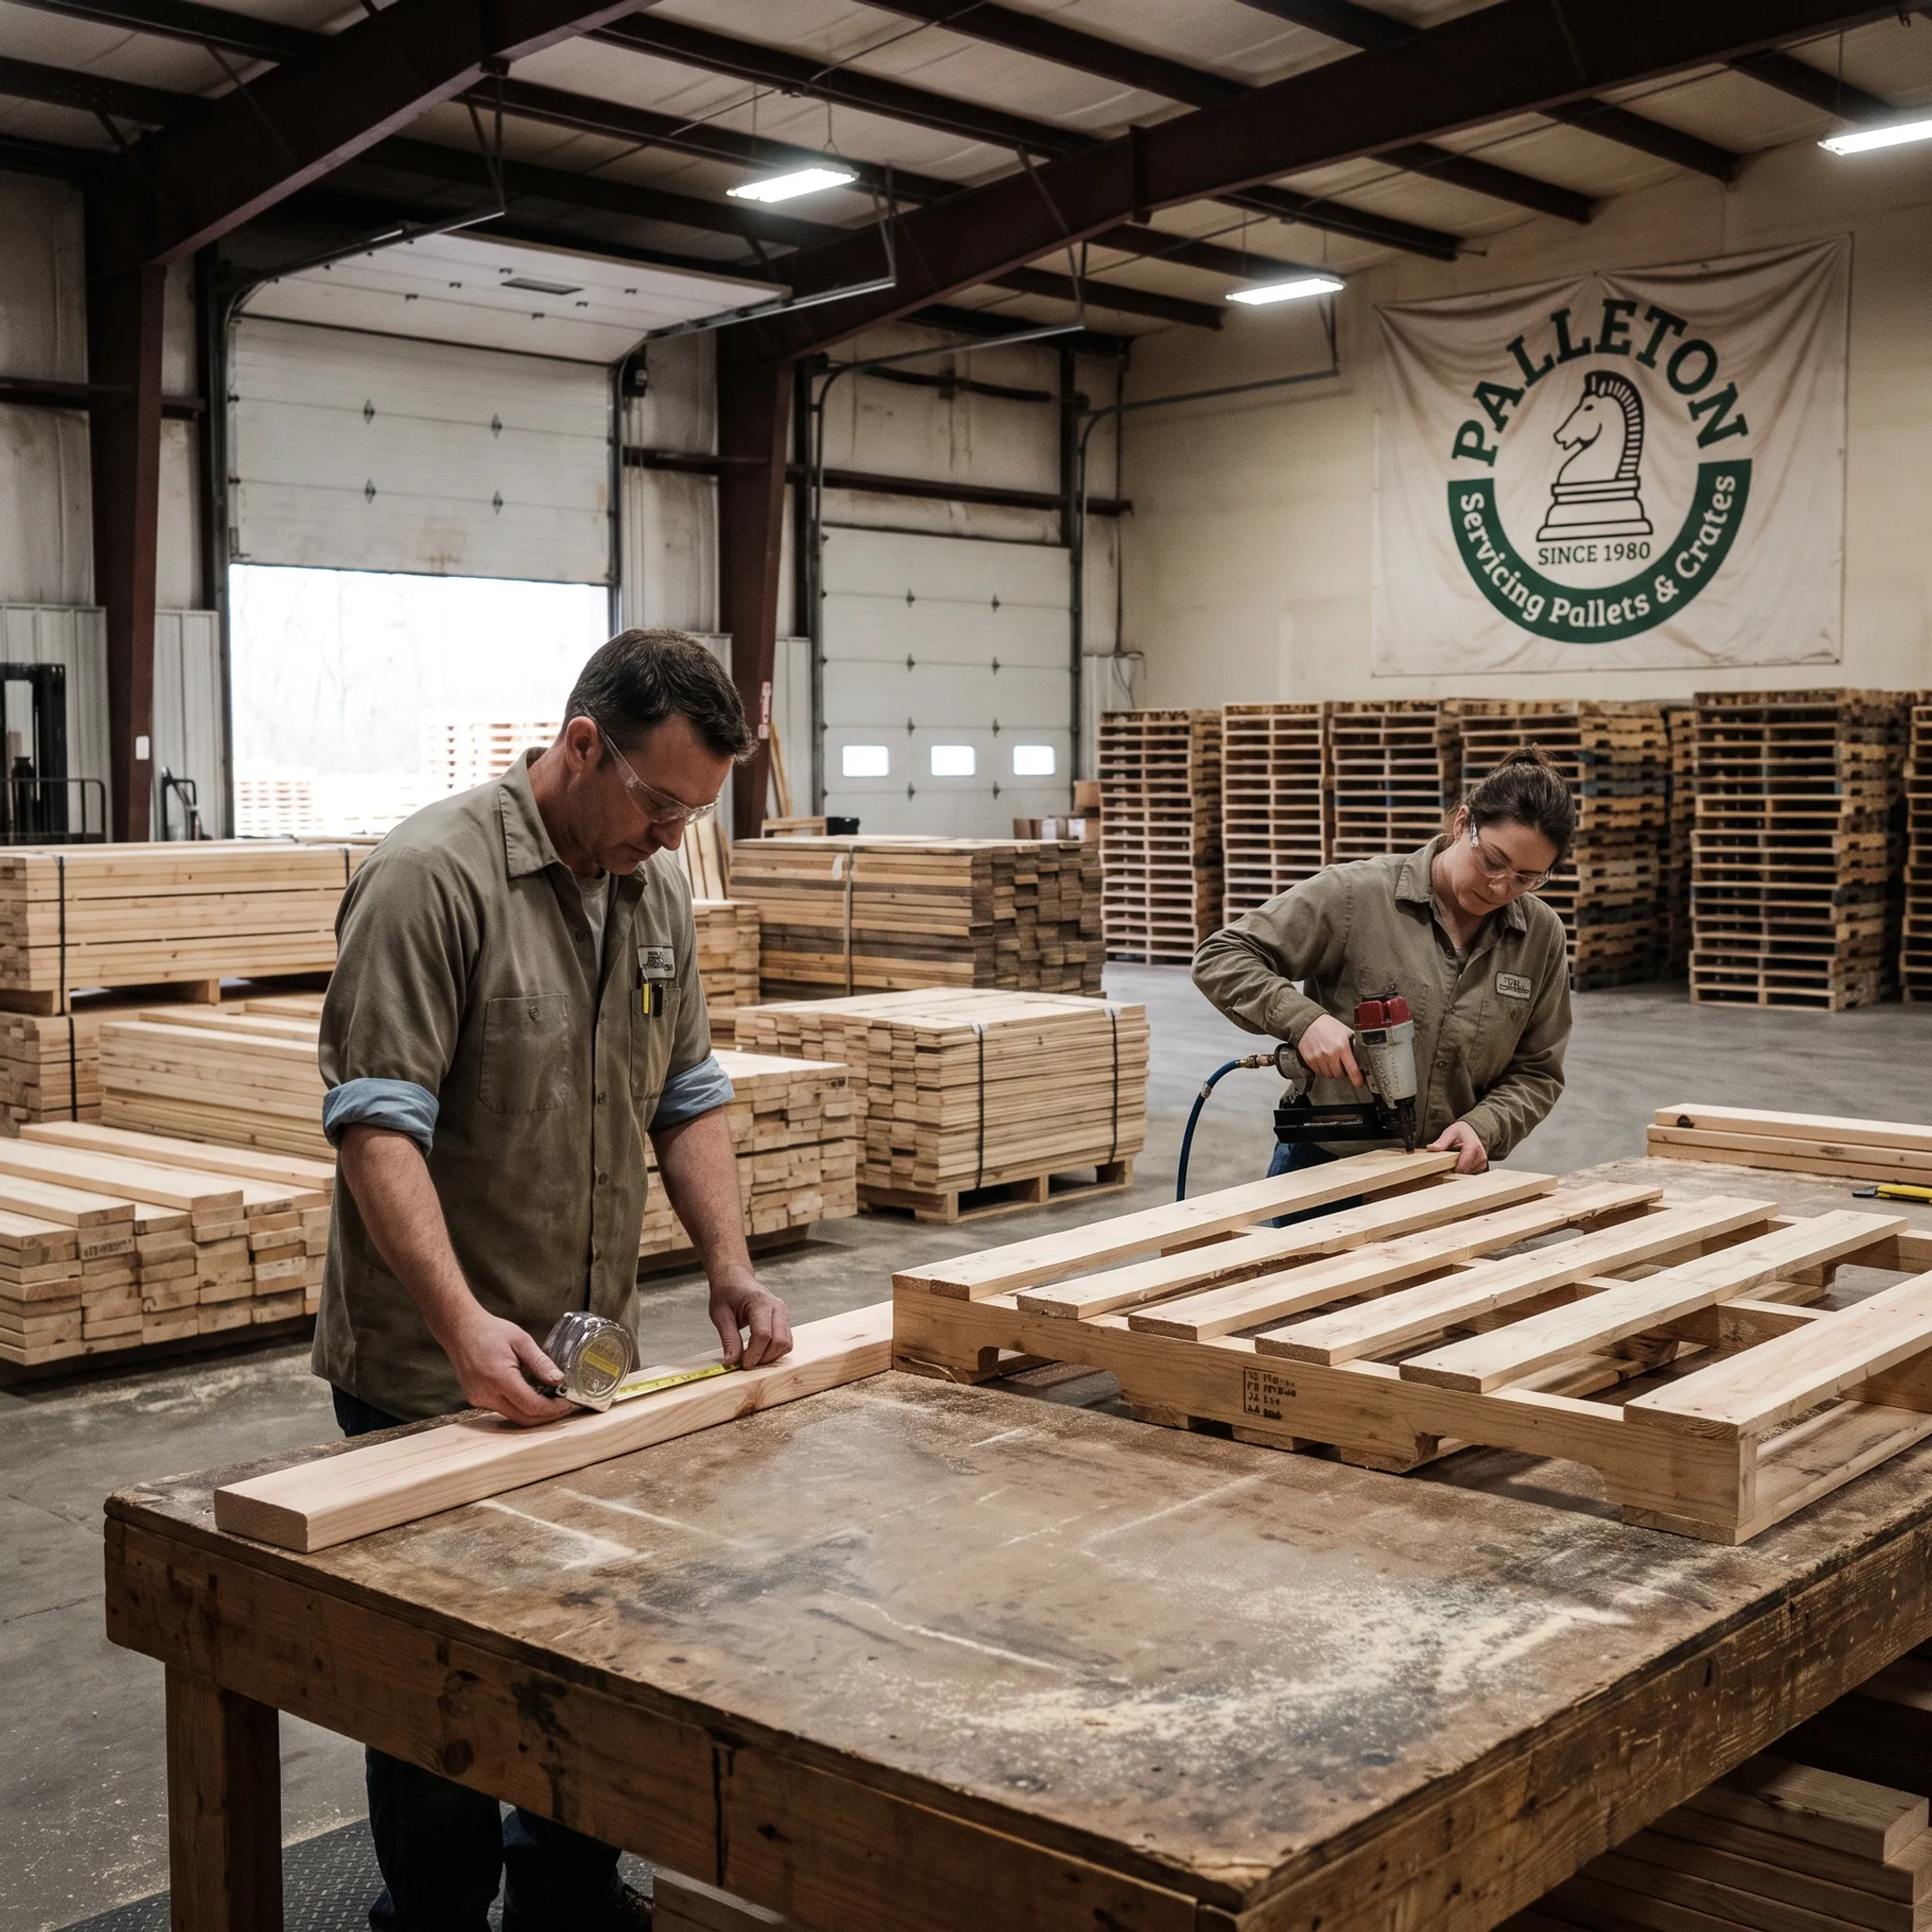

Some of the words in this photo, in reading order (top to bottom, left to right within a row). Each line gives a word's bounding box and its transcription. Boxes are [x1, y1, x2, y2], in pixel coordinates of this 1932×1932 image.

[1452, 298, 1750, 467] PALLETON
[1461, 492, 1545, 623] Servicing
[1548, 594, 1651, 628] Pallets
[1655, 575, 1680, 604] &
[1675, 475, 1735, 580] Crates
[1538, 546, 1597, 565] SINCE
[1604, 542, 1651, 562] 1980
